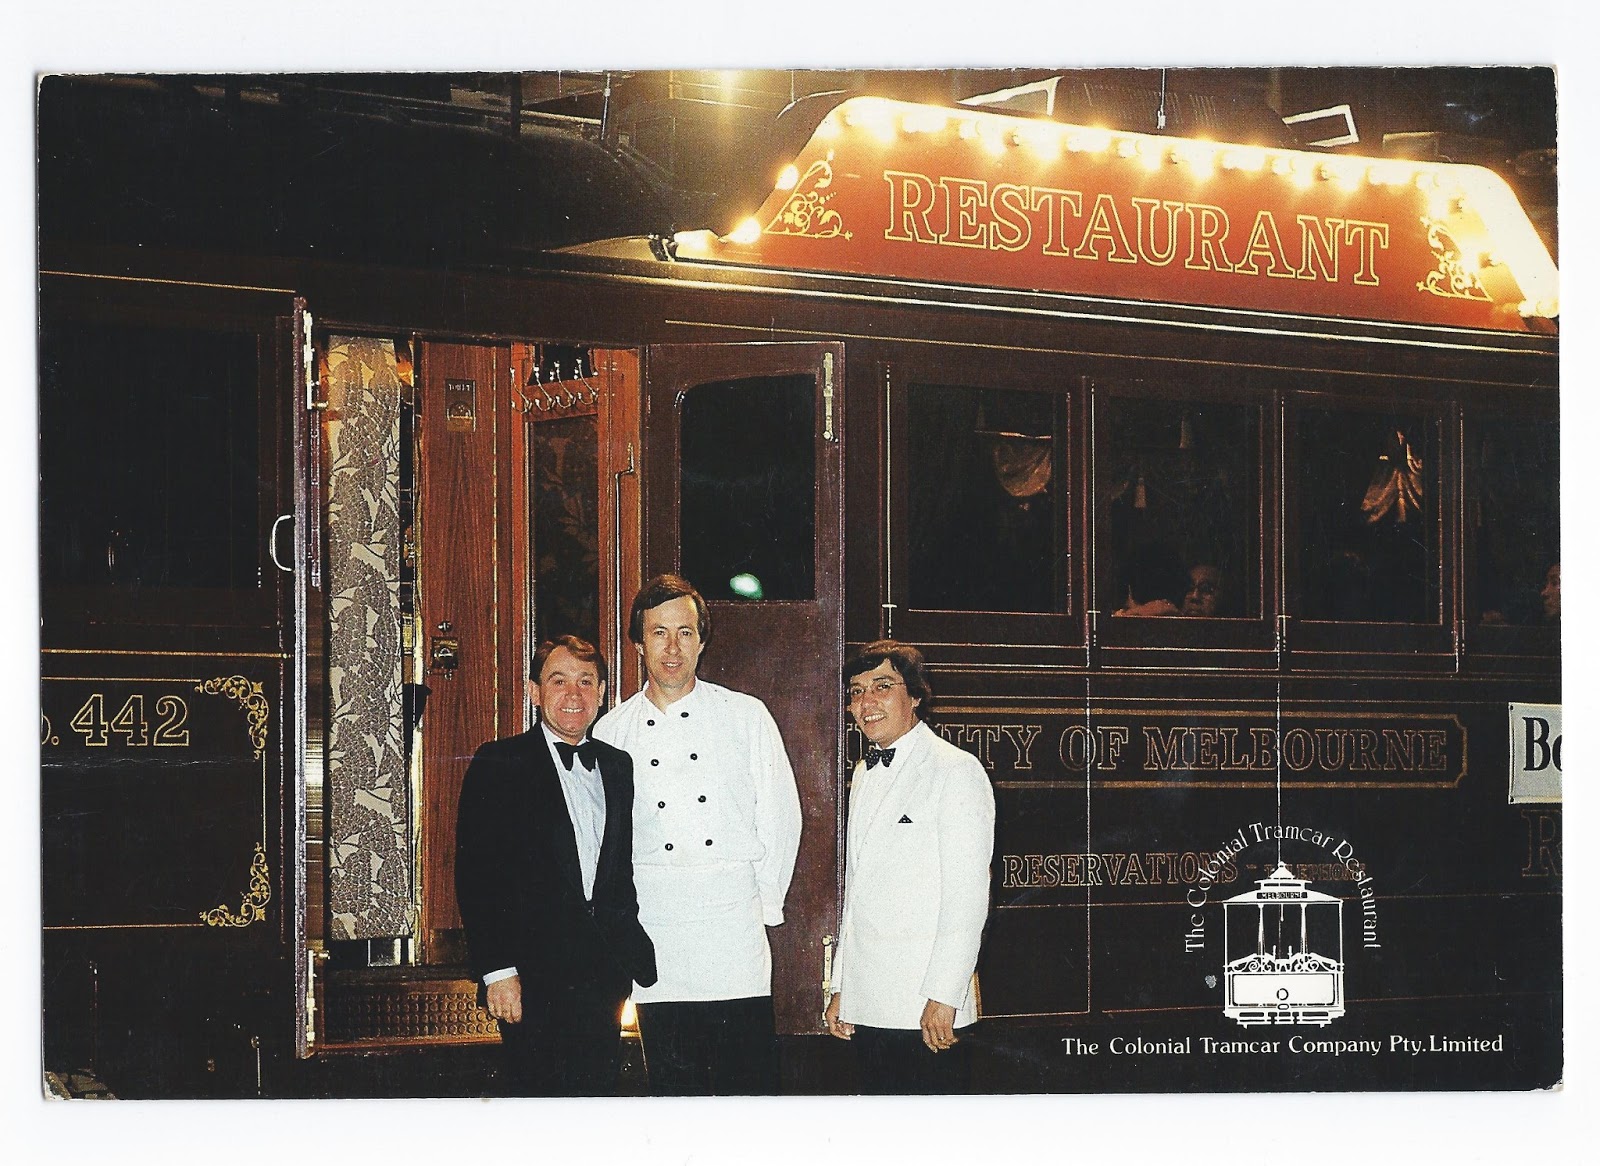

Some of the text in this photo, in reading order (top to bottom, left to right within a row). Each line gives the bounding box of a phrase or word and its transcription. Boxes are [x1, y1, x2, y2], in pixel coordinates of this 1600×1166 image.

[883, 170, 1390, 287] RESTAURANT
[70, 693, 190, 747] 442
[1059, 724, 1129, 771] OF
[1143, 726, 1448, 771] MELBOURNE
[1003, 852, 1239, 888] RESERVATIONS
